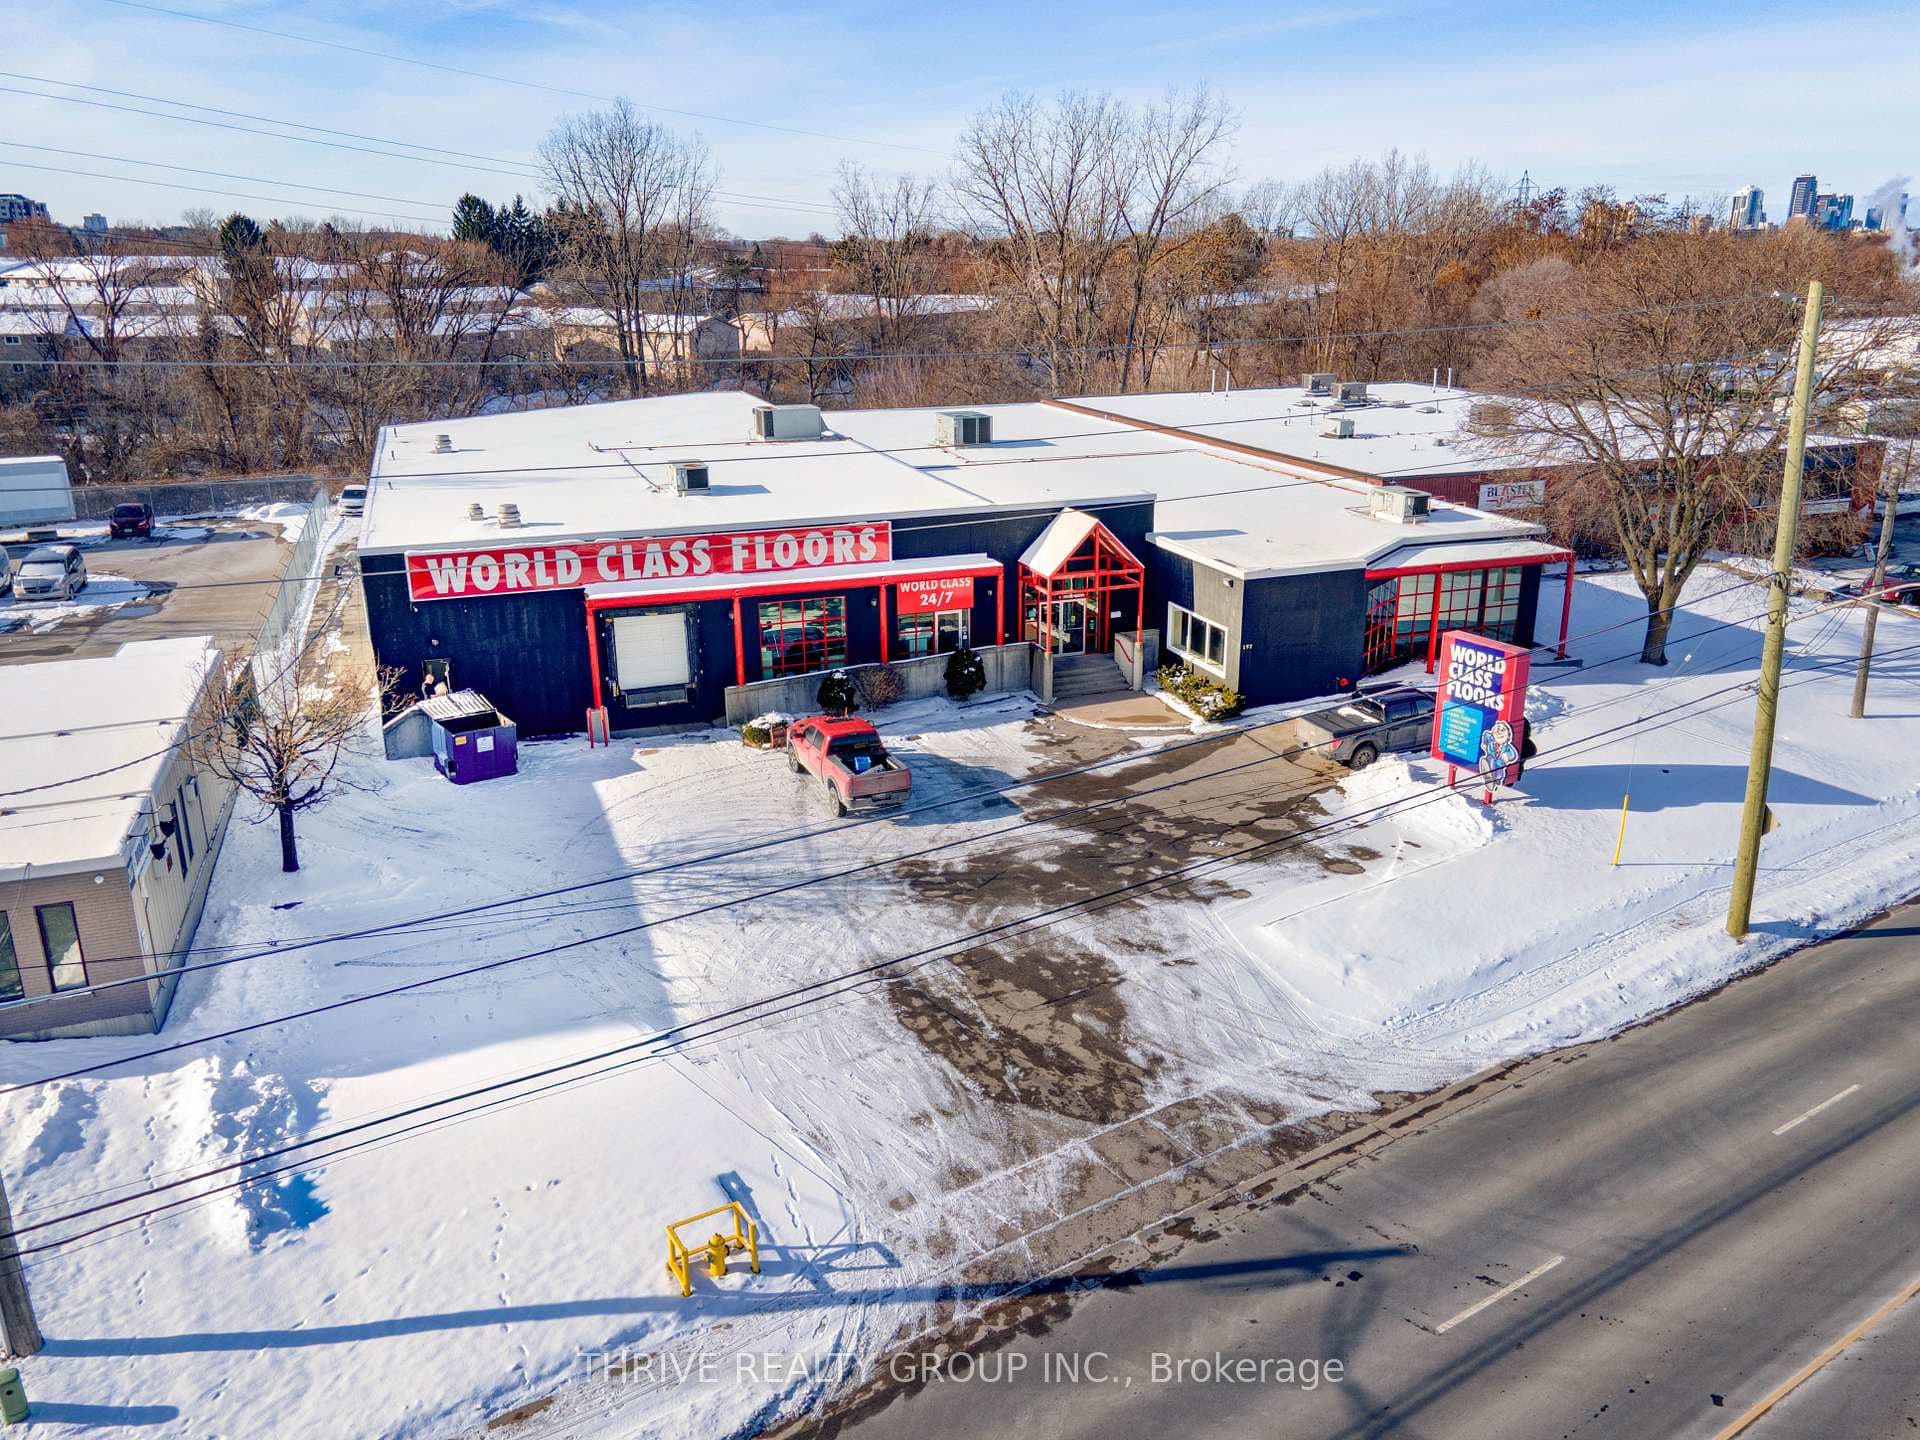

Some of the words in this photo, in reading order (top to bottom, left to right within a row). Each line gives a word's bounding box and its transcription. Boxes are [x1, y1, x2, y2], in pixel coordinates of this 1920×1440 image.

[426, 549, 582, 594] WORLD
[596, 539, 712, 582] CLASS
[731, 527, 878, 573] FLOORS
[900, 580, 938, 593] WORLD
[940, 577, 971, 589] CLASS
[920, 591, 953, 607] 24/7
[1450, 643, 1506, 674] WORLD
[1448, 661, 1493, 689] CLASS
[1446, 678, 1505, 711] FLOORS
